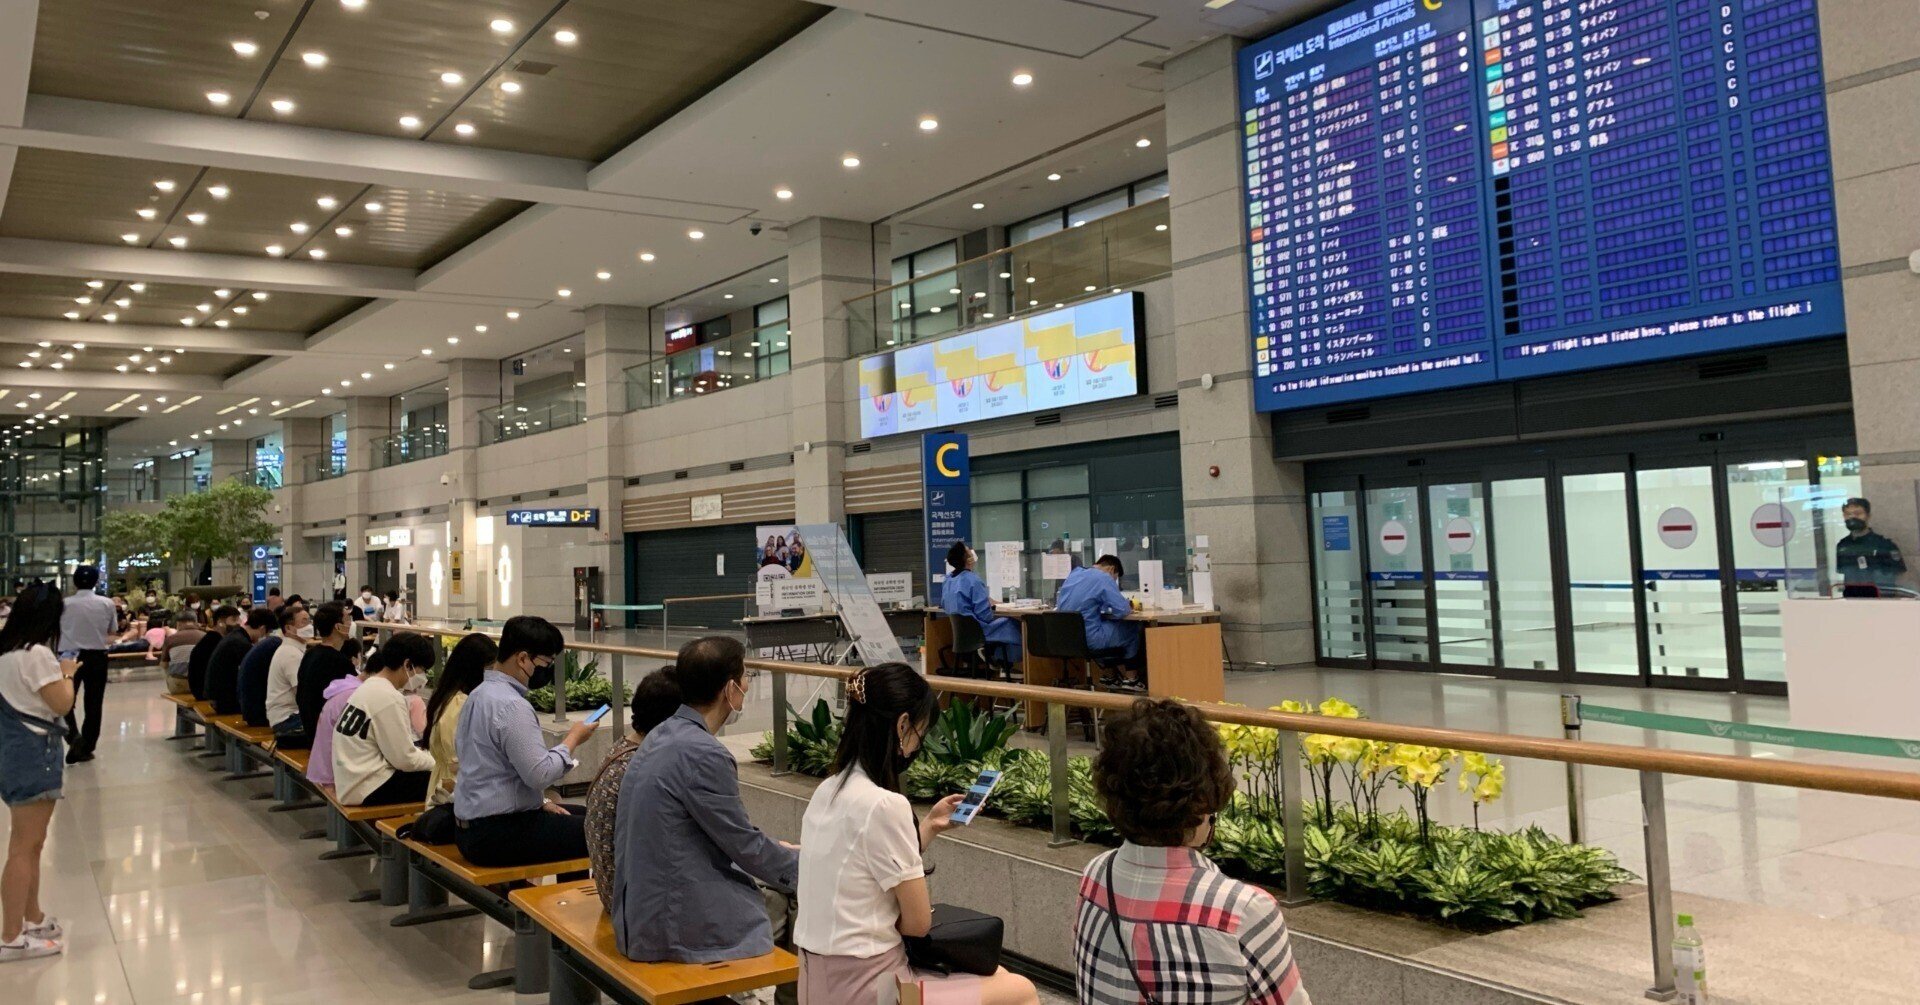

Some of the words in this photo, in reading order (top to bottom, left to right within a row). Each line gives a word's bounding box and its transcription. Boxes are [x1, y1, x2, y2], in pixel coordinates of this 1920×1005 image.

[1328, 20, 1380, 50] International
[1381, 7, 1416, 29] Arrivals
[1580, 10, 1616, 30] サイパン
[1583, 46, 1609, 61] マニラ
[1722, 6, 1730, 17] D
[1276, 42, 1304, 65] 국제선
[1306, 34, 1324, 54] 도착
[1407, 51, 1412, 60] C
[1521, 55, 1534, 66] 112
[1581, 27, 1618, 46] サイパン
[1584, 60, 1621, 80] サイパン
[1723, 24, 1732, 34] C
[1408, 66, 1413, 74] C
[1586, 81, 1612, 96] グアム
[1724, 42, 1733, 52] C
[1409, 81, 1414, 89] C
[1587, 97, 1614, 113] グアム
[1726, 60, 1735, 70] C
[1410, 110, 1416, 119] C
[1588, 114, 1615, 130] グアム
[1728, 78, 1736, 88] C
[1729, 96, 1738, 108] D
[1315, 113, 1366, 137] サンフランシスコ
[1410, 96, 1416, 104] D
[1412, 126, 1417, 134] D
[1412, 140, 1418, 149] C
[1413, 155, 1419, 164] C
[1414, 168, 1421, 178] C
[1415, 185, 1421, 194] C
[1321, 226, 1339, 236] ドーハ
[1416, 202, 1422, 210] D
[1322, 239, 1338, 250] ドバイ
[1417, 217, 1423, 226] D
[1323, 251, 1346, 264] トロント
[1418, 232, 1424, 240] D
[1322, 266, 1348, 278] ホノルル
[1419, 247, 1424, 255] C
[1324, 280, 1349, 292] シアトル
[1420, 262, 1425, 270] C
[1421, 277, 1426, 286] C
[1325, 305, 1363, 320] ニューヨーク
[1422, 292, 1427, 300] C
[1325, 324, 1344, 333] マニラ
[1422, 307, 1428, 316] C
[1327, 334, 1373, 348] イスタンブール
[1424, 322, 1430, 331] D
[1552, 338, 1578, 350] flight
[1582, 336, 1592, 346] is
[1611, 328, 1640, 342] listed
[1669, 321, 1699, 334] please
[1703, 316, 1728, 328] refer
[1732, 312, 1744, 324] to
[1748, 310, 1764, 321] the
[1769, 303, 1802, 318] flight
[1327, 348, 1374, 362] ウランバートル
[1424, 338, 1430, 346] D
[1300, 378, 1318, 388] flight
[1385, 364, 1410, 376] located
[1422, 361, 1434, 370] the
[1435, 356, 1460, 368] arrival
[936, 442, 960, 478] C
[571, 510, 590, 522] D-F
[1732, 729, 1764, 740] Incheon
[1766, 734, 1796, 744] Airport
